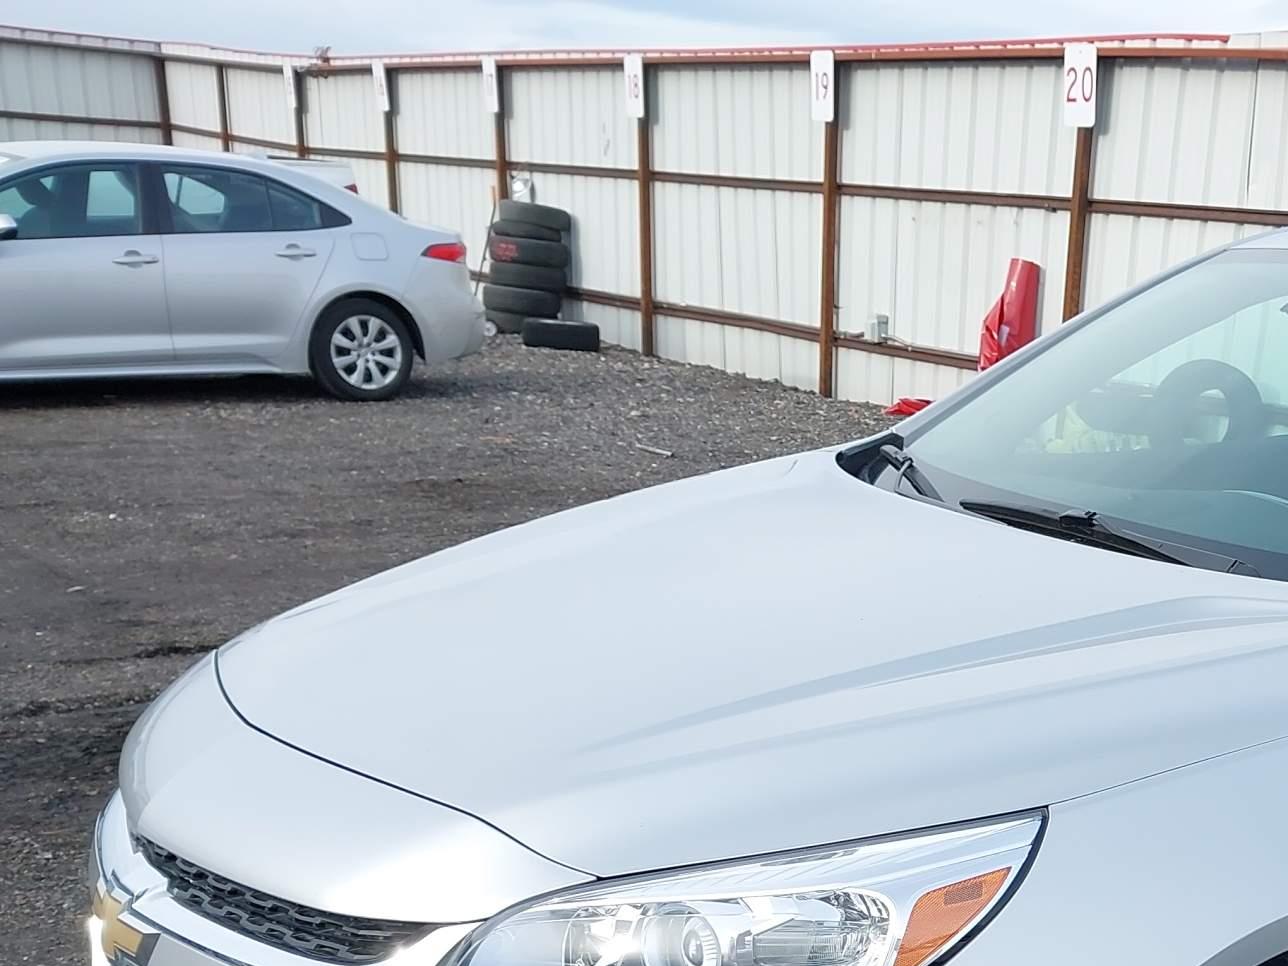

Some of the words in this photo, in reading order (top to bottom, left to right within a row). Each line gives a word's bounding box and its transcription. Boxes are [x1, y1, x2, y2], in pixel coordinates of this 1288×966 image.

[627, 74, 640, 99] 18
[815, 71, 830, 100] 19
[1066, 66, 1093, 102] 20
